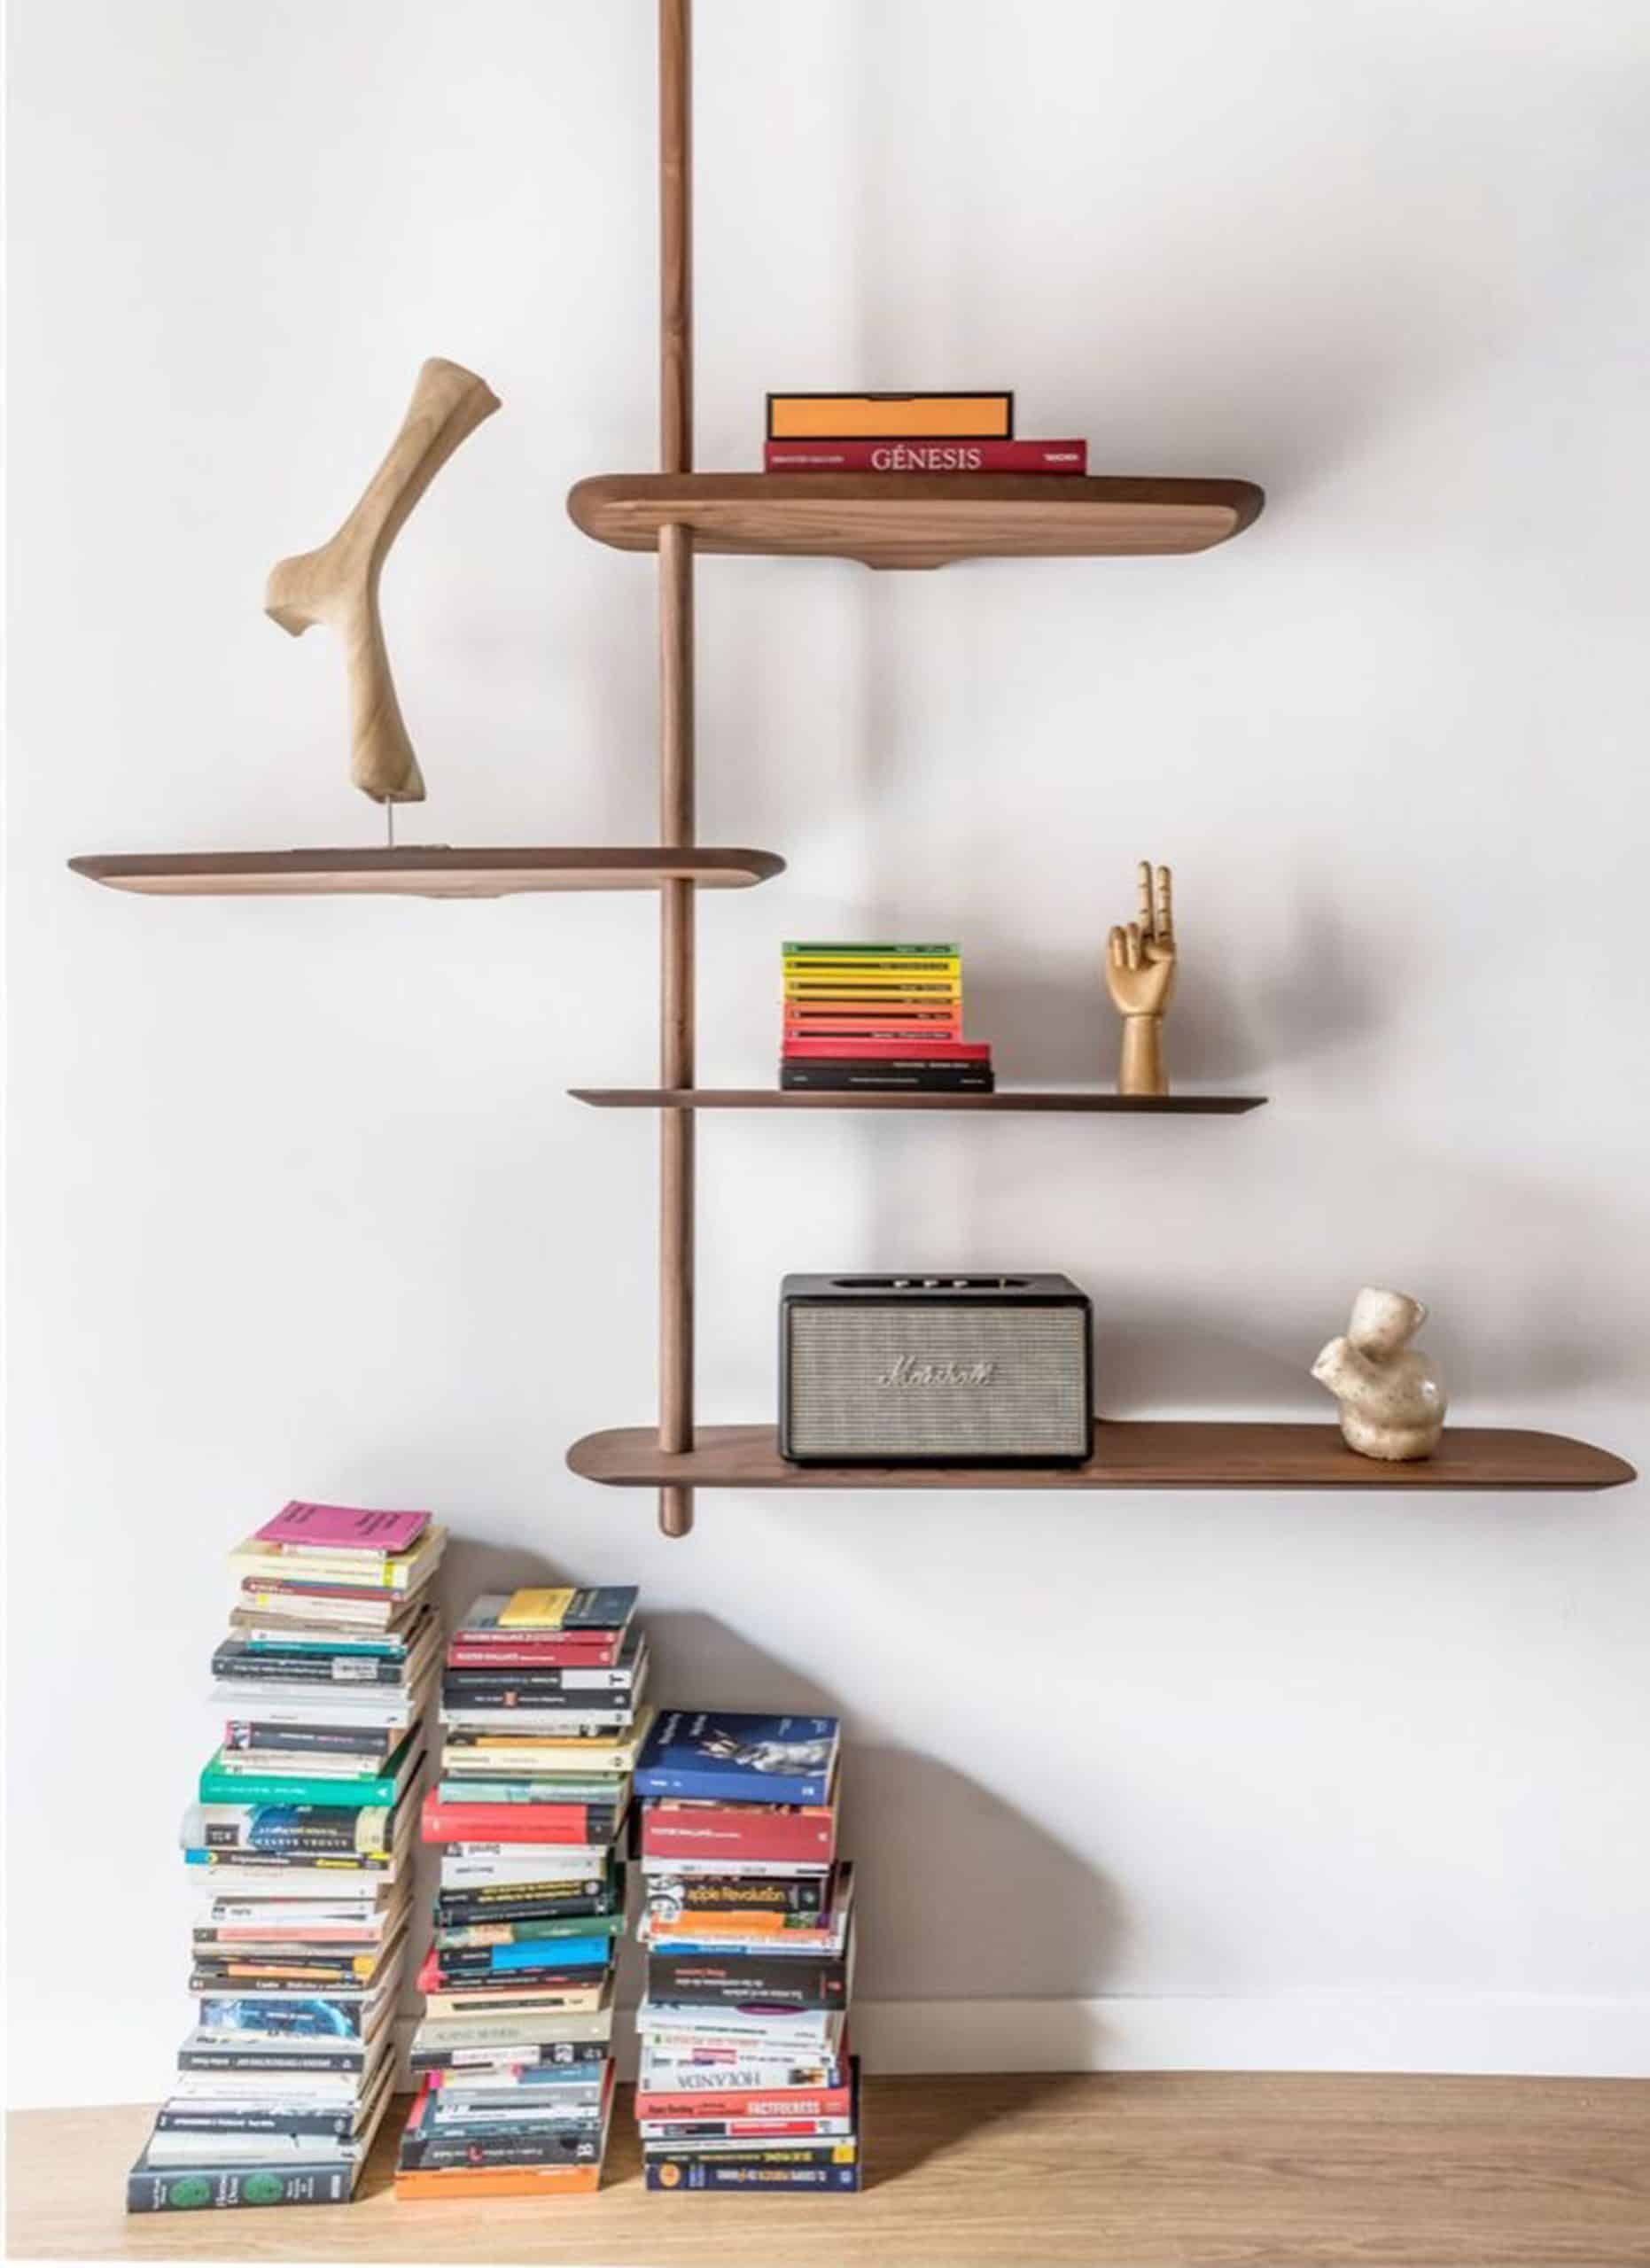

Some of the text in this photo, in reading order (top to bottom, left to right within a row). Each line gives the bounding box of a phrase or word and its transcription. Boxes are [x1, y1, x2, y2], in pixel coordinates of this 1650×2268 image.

[871, 444, 982, 470] GÉNESIS
[878, 1353, 1002, 1389] Marshall
[723, 1885, 786, 1902] Revolution
[677, 2070, 762, 2089] HOLANDA
